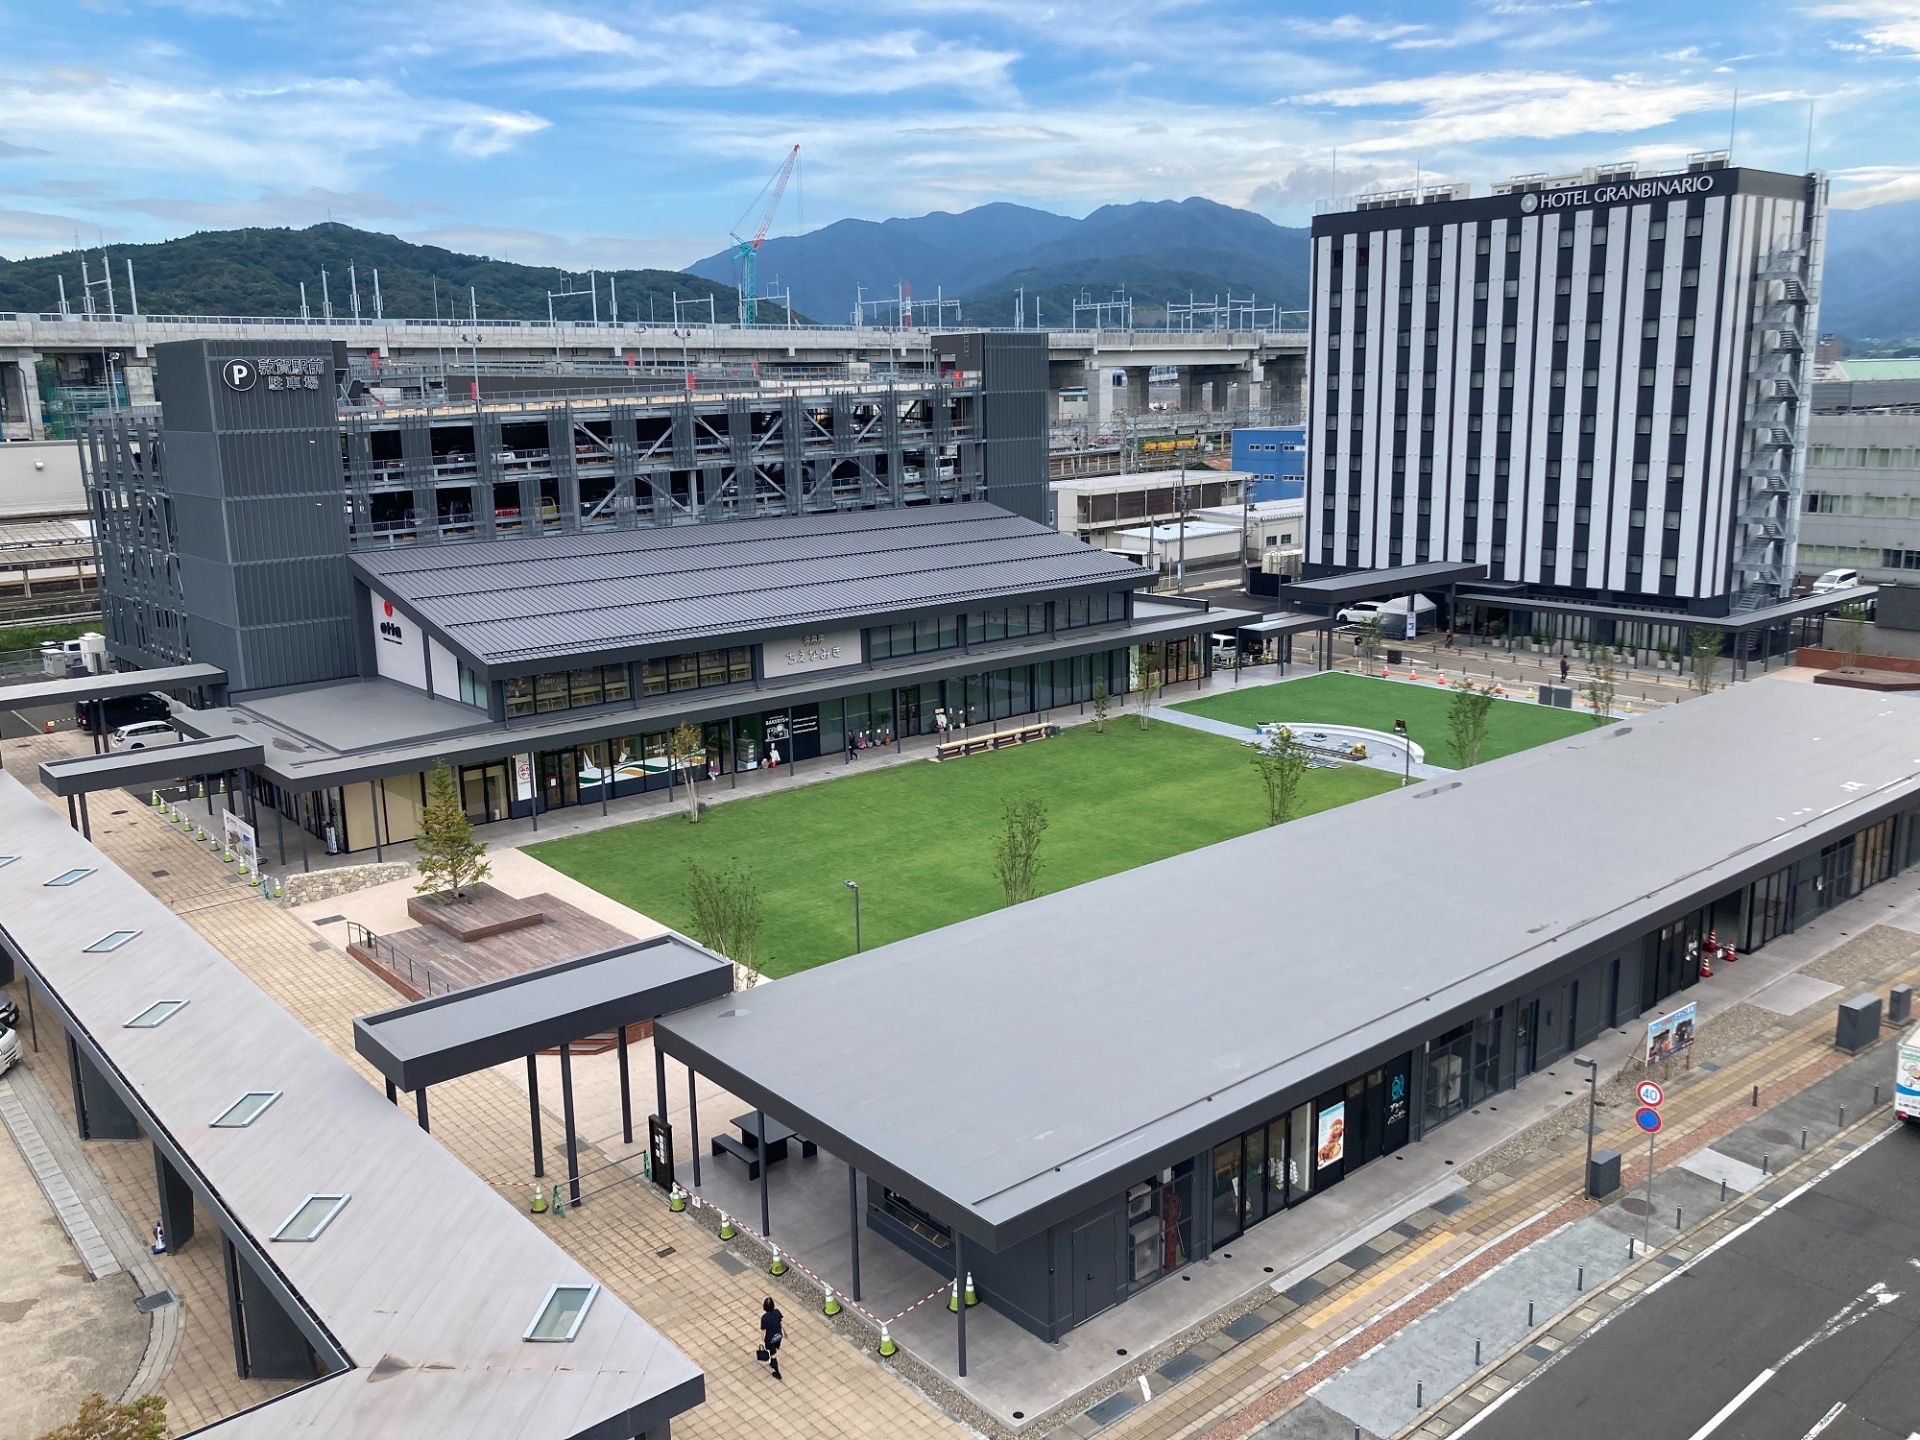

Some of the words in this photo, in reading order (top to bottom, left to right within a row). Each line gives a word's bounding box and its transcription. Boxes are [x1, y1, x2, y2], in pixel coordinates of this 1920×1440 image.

[1540, 190, 1592, 209] HOTEL
[1594, 176, 1713, 202] GRANBINARIO
[233, 365, 247, 384] P
[258, 358, 325, 375] 敦賀駅前
[268, 375, 320, 390] 駐車場
[786, 646, 841, 665] ちえなみき
[1642, 1088, 1658, 1101] 40
